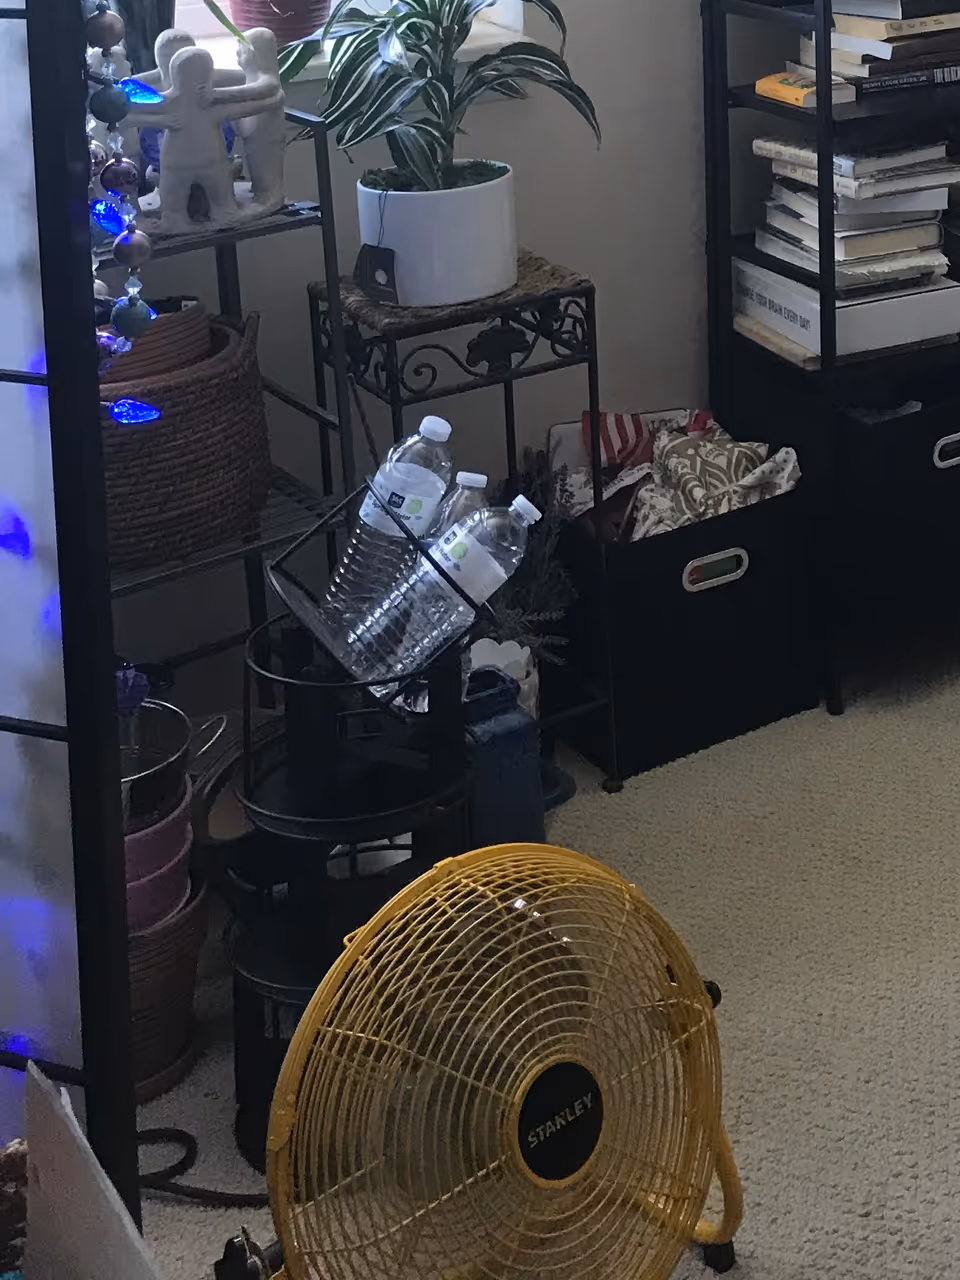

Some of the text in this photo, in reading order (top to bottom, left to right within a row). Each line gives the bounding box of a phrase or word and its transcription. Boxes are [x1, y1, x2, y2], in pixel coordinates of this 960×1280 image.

[862, 80, 881, 89] HENRY
[882, 79, 898, 87] LOUIS
[933, 68, 944, 84] THE
[768, 298, 783, 316] BRAIN
[783, 307, 799, 325] EVERY
[527, 1091, 593, 1149] STANLEY
